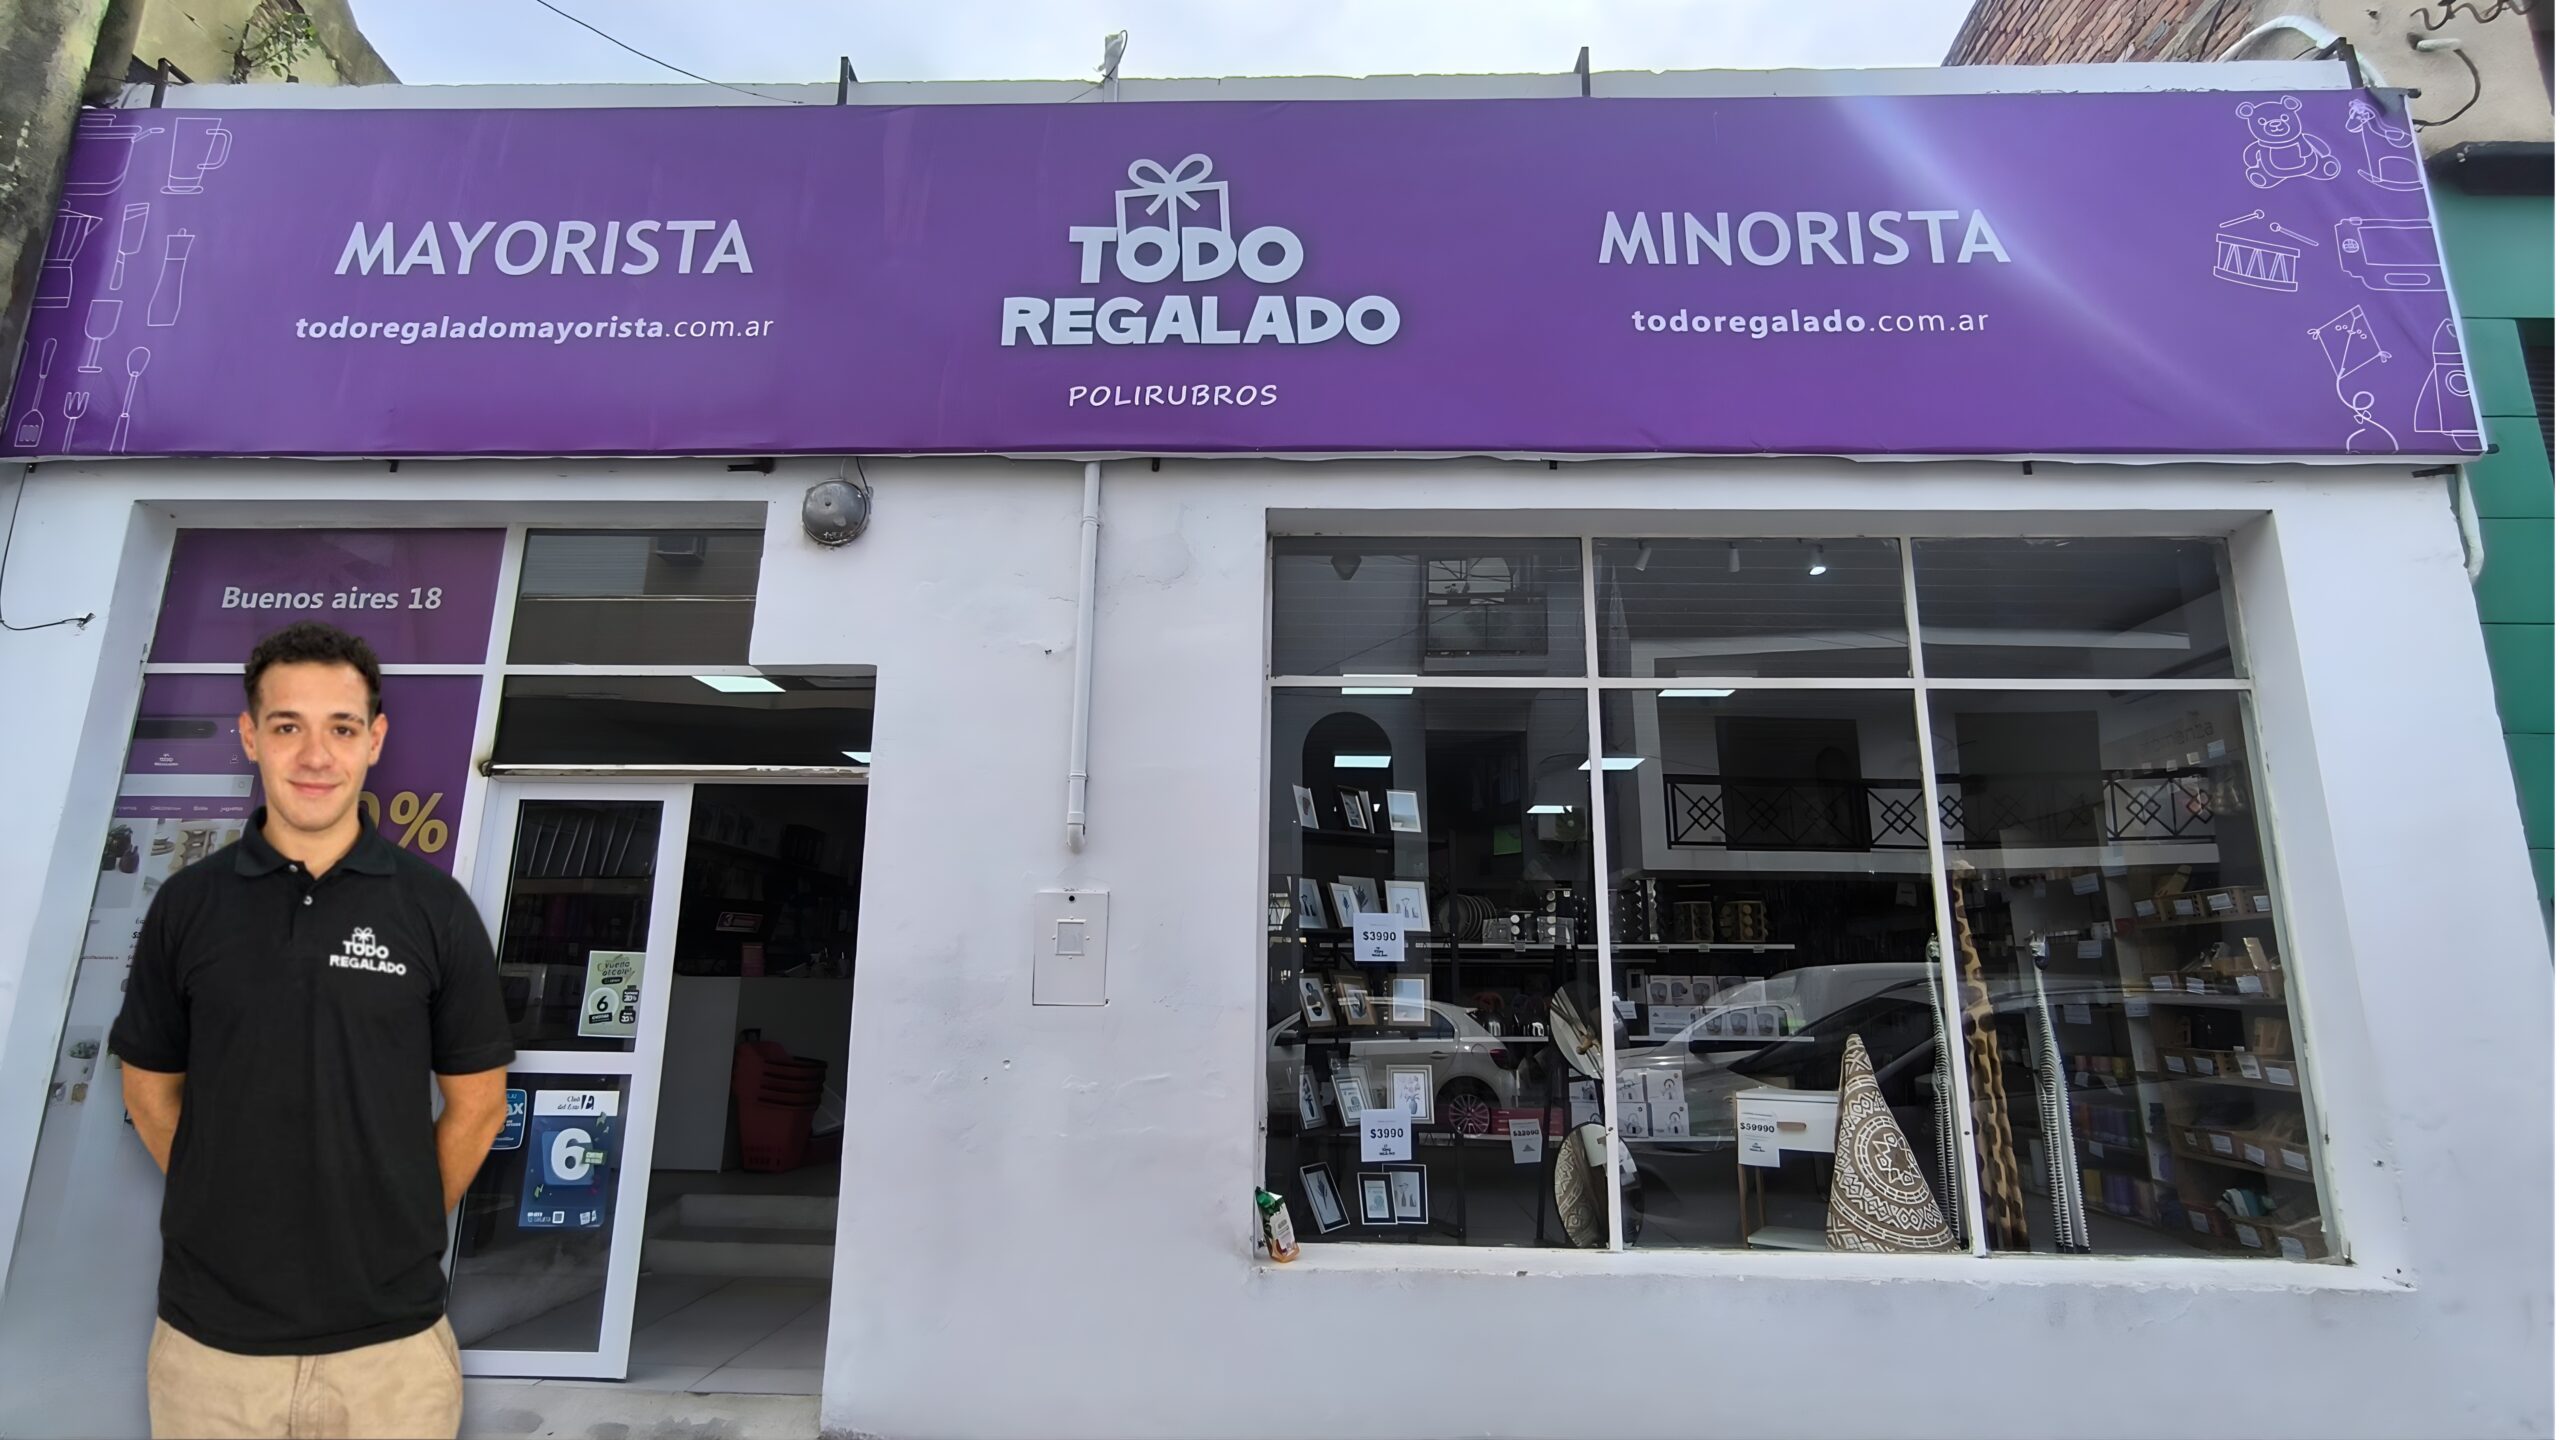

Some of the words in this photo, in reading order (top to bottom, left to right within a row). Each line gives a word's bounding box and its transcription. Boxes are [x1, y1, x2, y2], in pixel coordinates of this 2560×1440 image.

[335, 219, 754, 276] MAYORISTA
[1598, 209, 2011, 266] MINORISTA
[1069, 225, 1304, 284] TODO
[295, 315, 774, 344] todoregaladomayorista.com.ar
[1001, 295, 1401, 346] REGALADO
[1632, 308, 1989, 339] todoregalado.com.ar
[1068, 384, 1278, 407] POLIRUBROS
[221, 586, 324, 610] Buenos
[331, 586, 399, 610] aires
[407, 587, 443, 610] 18
[1362, 931, 1397, 941] $3990
[342, 940, 390, 959] TODO
[329, 954, 407, 976] REGALADO
[596, 995, 609, 1012] 6
[1370, 1128, 1404, 1139] $3990
[551, 1128, 592, 1180] 6
